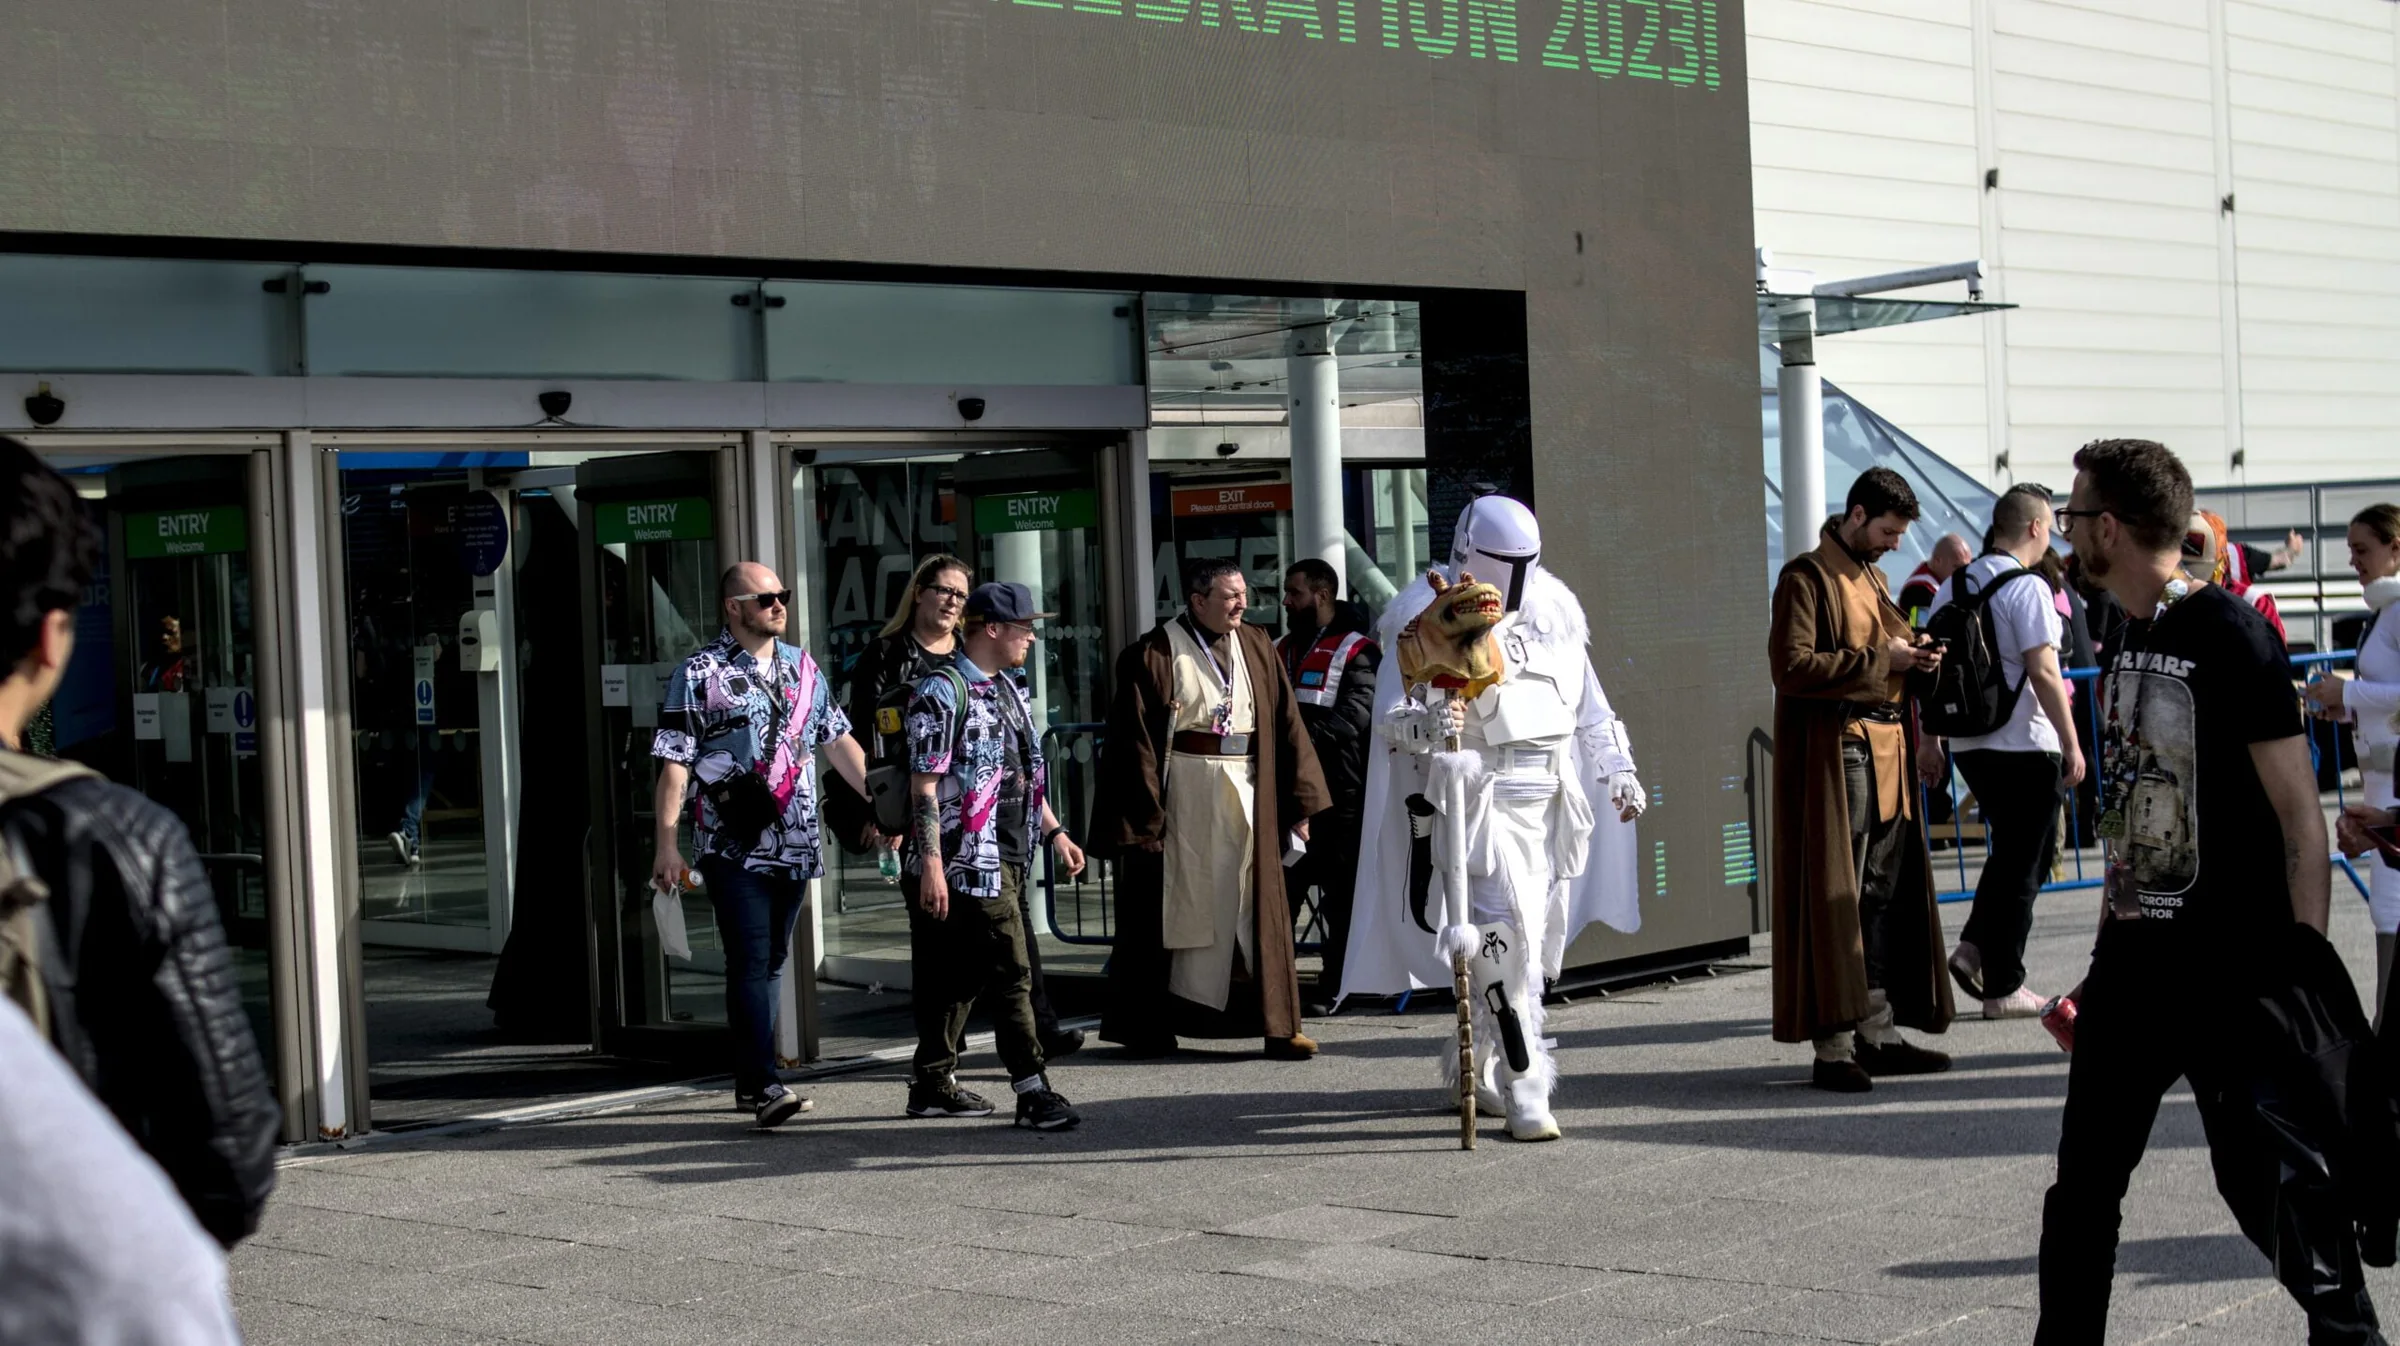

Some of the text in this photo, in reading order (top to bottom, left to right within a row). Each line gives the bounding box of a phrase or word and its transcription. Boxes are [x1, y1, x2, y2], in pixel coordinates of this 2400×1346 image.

[1542, 0, 1720, 91] 2023!
[1218, 489, 1246, 503] EXIT
[1007, 495, 1060, 517] ENTRY
[1190, 500, 1275, 513] Please use central doors
[627, 502, 678, 525] ENTRY
[157, 512, 210, 537] ENTRY
[1014, 518, 1055, 531] Welcome
[634, 528, 673, 541] Welcome
[165, 540, 205, 554] Welcome
[2135, 651, 2197, 678] WARS
[2143, 895, 2184, 907] DROIDS
[2150, 908, 2174, 919] FOR
